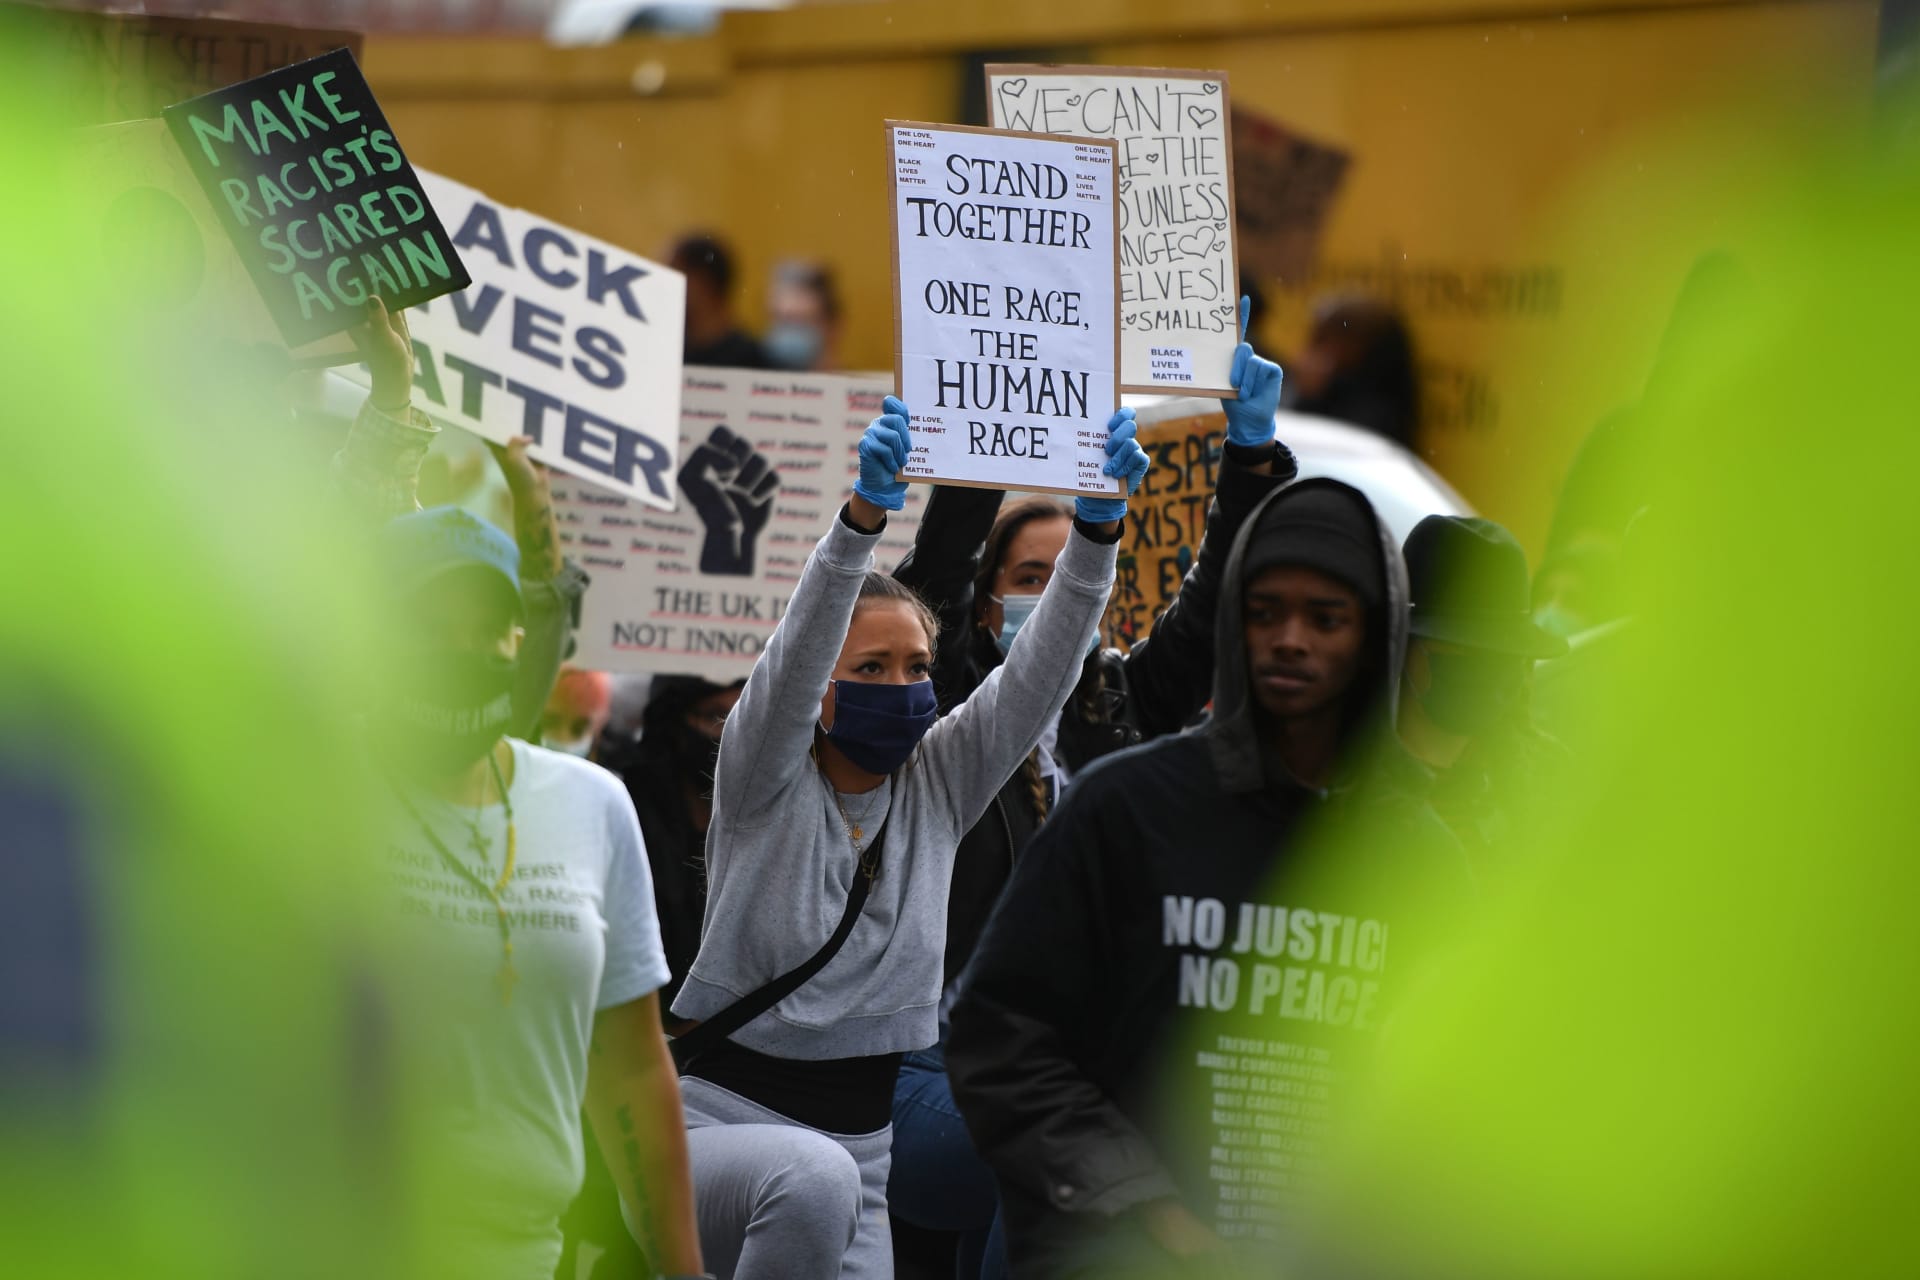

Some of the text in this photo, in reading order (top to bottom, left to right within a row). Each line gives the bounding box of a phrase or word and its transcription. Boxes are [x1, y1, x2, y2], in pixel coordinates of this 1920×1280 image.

[188, 71, 361, 167] MAKE
[998, 83, 1206, 134] WE CAN'T
[913, 131, 933, 140] LOVE,
[913, 141, 936, 149] HEART
[1089, 147, 1108, 155] LOVE,
[898, 158, 921, 166] BLACK
[1089, 156, 1111, 164] HEART
[1152, 137, 1219, 176] THE
[220, 124, 402, 226] RACIST'S
[899, 177, 926, 185] MATTER
[946, 153, 1068, 200] STAND
[1076, 192, 1101, 200] MATTER
[1134, 182, 1228, 228] UNLESS
[260, 185, 425, 274] SCARED
[906, 197, 1092, 250] TOGETHER
[292, 230, 451, 320] AGAIN
[452, 202, 652, 325] ACK
[1121, 258, 1225, 303] ELVES!
[925, 279, 990, 317] ONE
[1004, 286, 1089, 331] RACE,
[412, 283, 627, 389] VES
[970, 328, 1038, 361] THE
[1151, 348, 1183, 357] BLACK
[1152, 360, 1180, 369] LIVES
[1152, 372, 1192, 381] MATTER
[934, 359, 1090, 419] HUMAN
[411, 337, 671, 501] ATTER
[922, 416, 943, 425] LOVE,
[922, 426, 946, 434] HEART
[967, 421, 1049, 460] RACE
[905, 466, 934, 474] MATTER
[1078, 461, 1099, 469] BLACK
[1078, 471, 1097, 479] LIVES
[1078, 481, 1105, 489] MATTER
[655, 586, 712, 615] THE
[720, 592, 762, 619] UK
[612, 622, 767, 654] NOT INNO
[1162, 895, 1390, 976] NO JUSTIC
[1178, 954, 1382, 1031] NO PEACE
